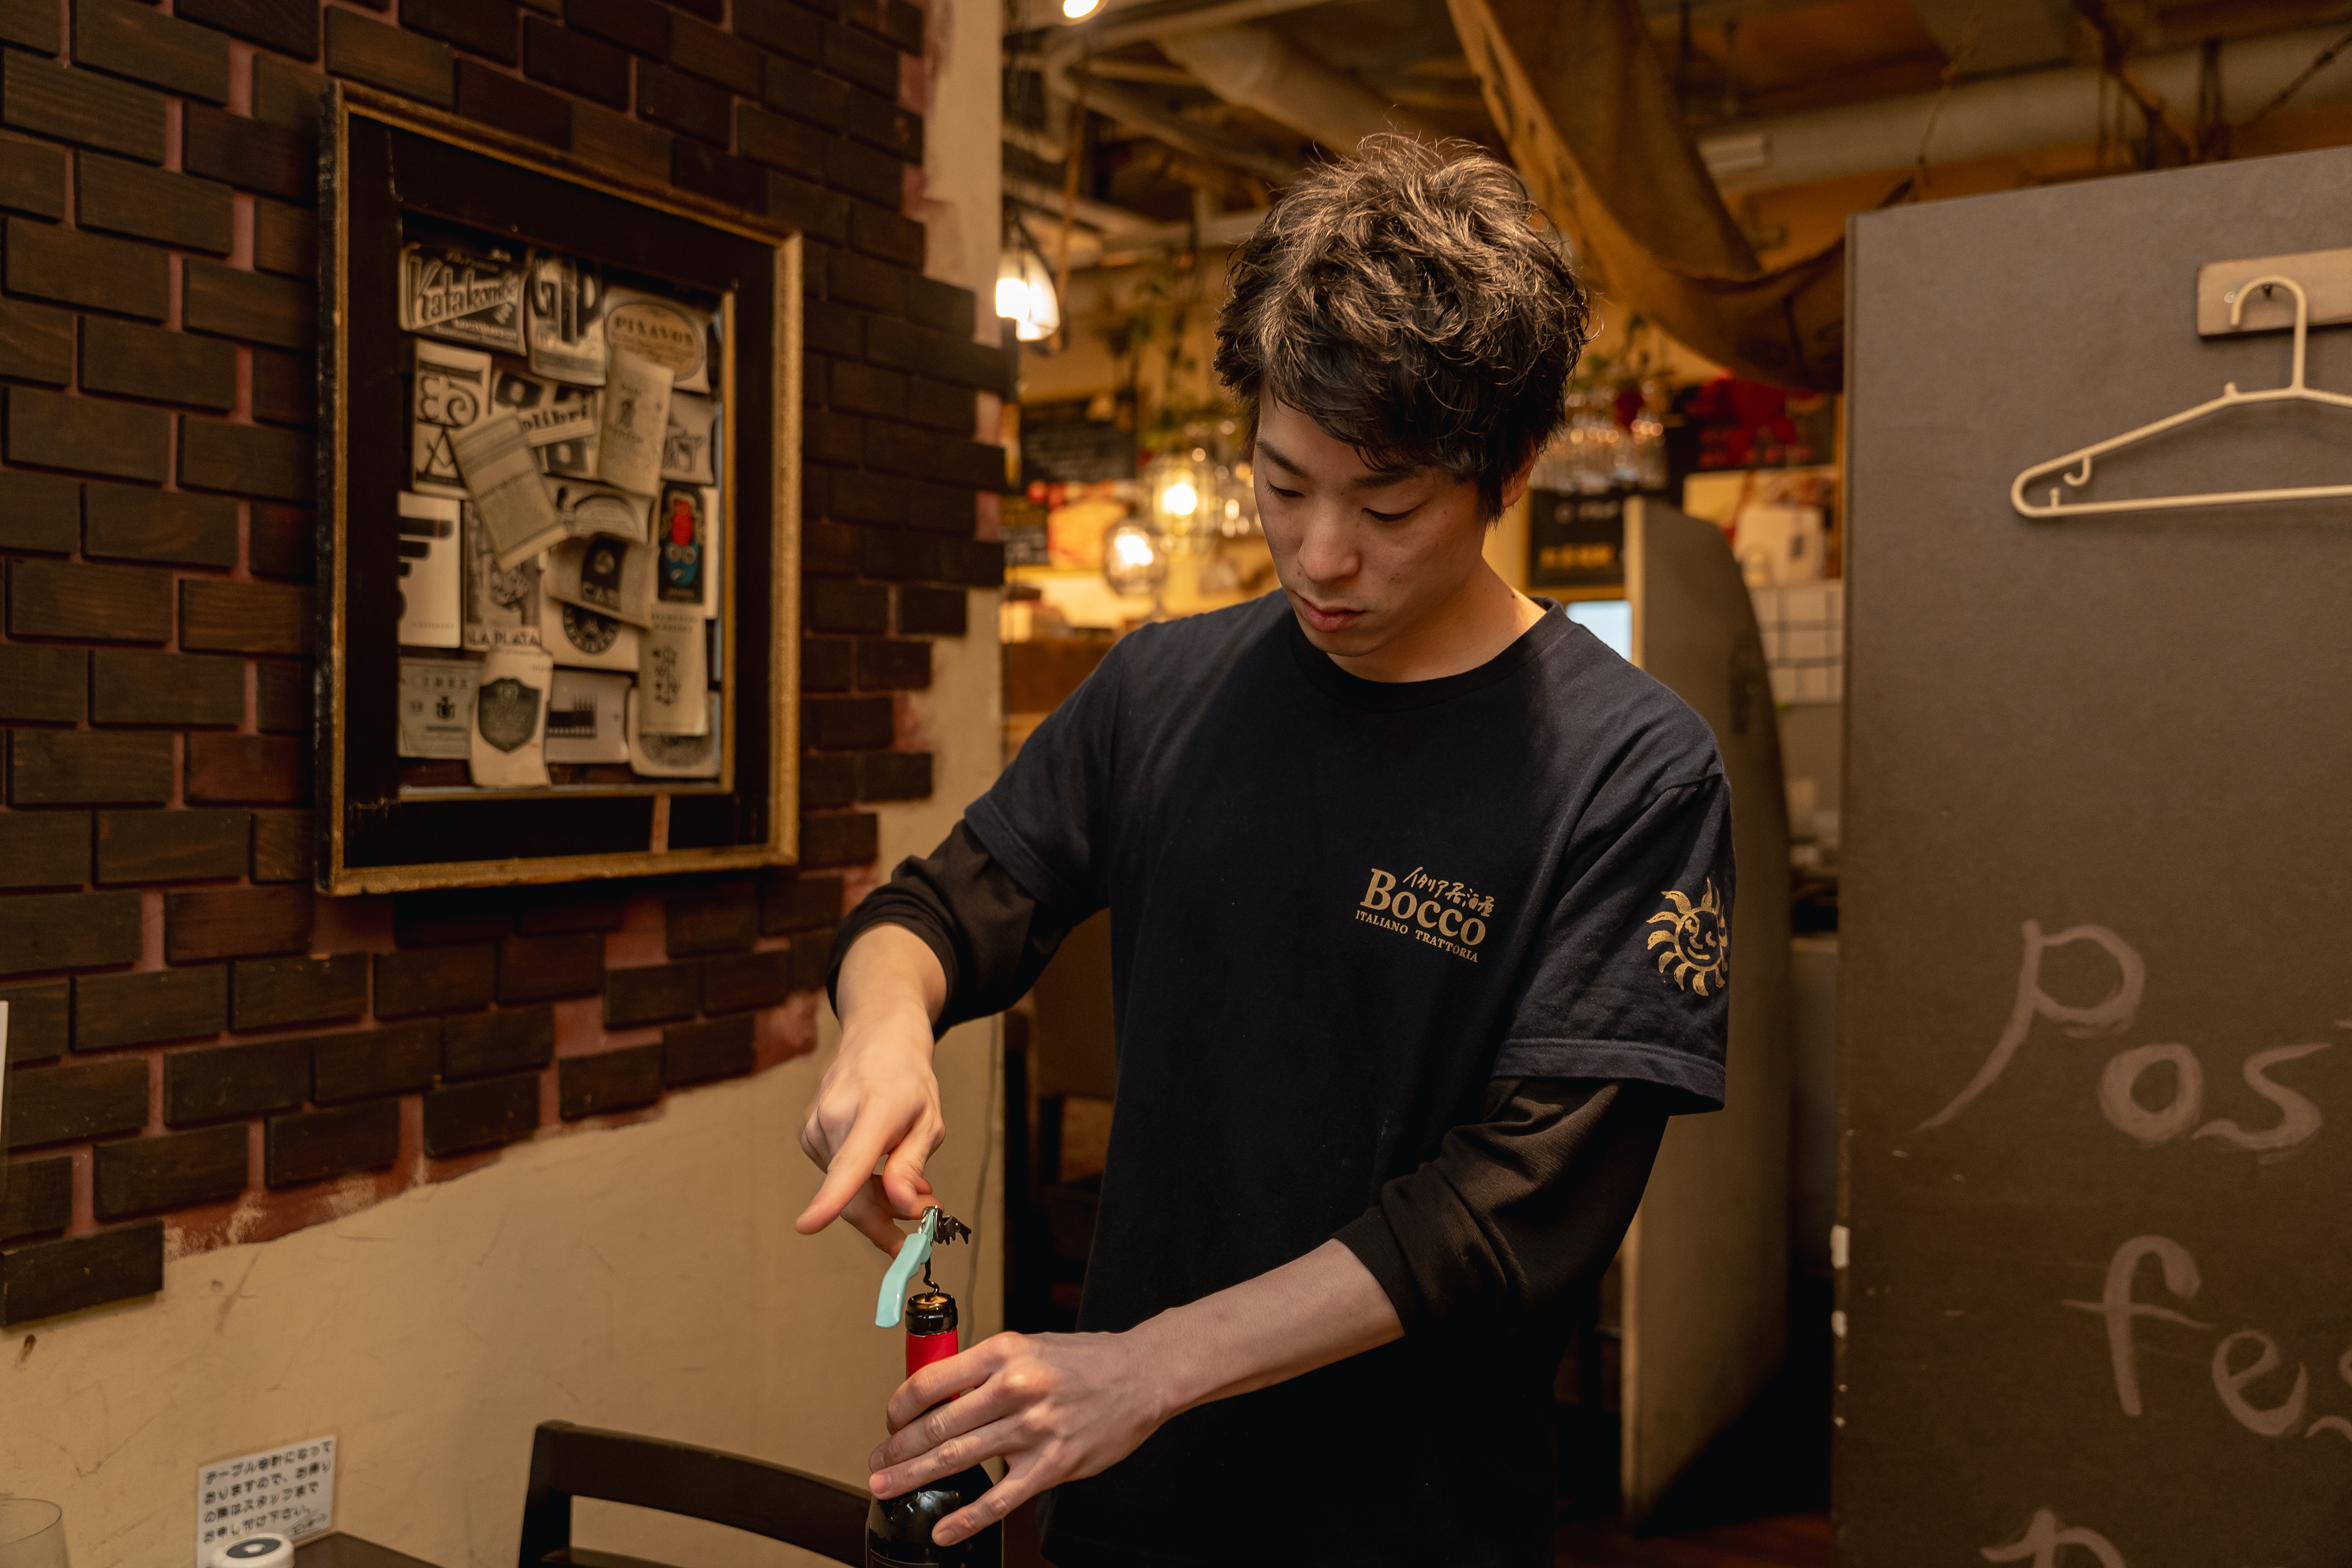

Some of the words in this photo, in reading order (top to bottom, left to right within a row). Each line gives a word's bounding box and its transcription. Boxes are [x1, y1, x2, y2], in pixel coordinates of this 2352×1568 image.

[1355, 910, 1408, 934] ITALIANO
[1415, 930, 1478, 963] TRATTORIA
[1915, 919, 2352, 1153] Pos
